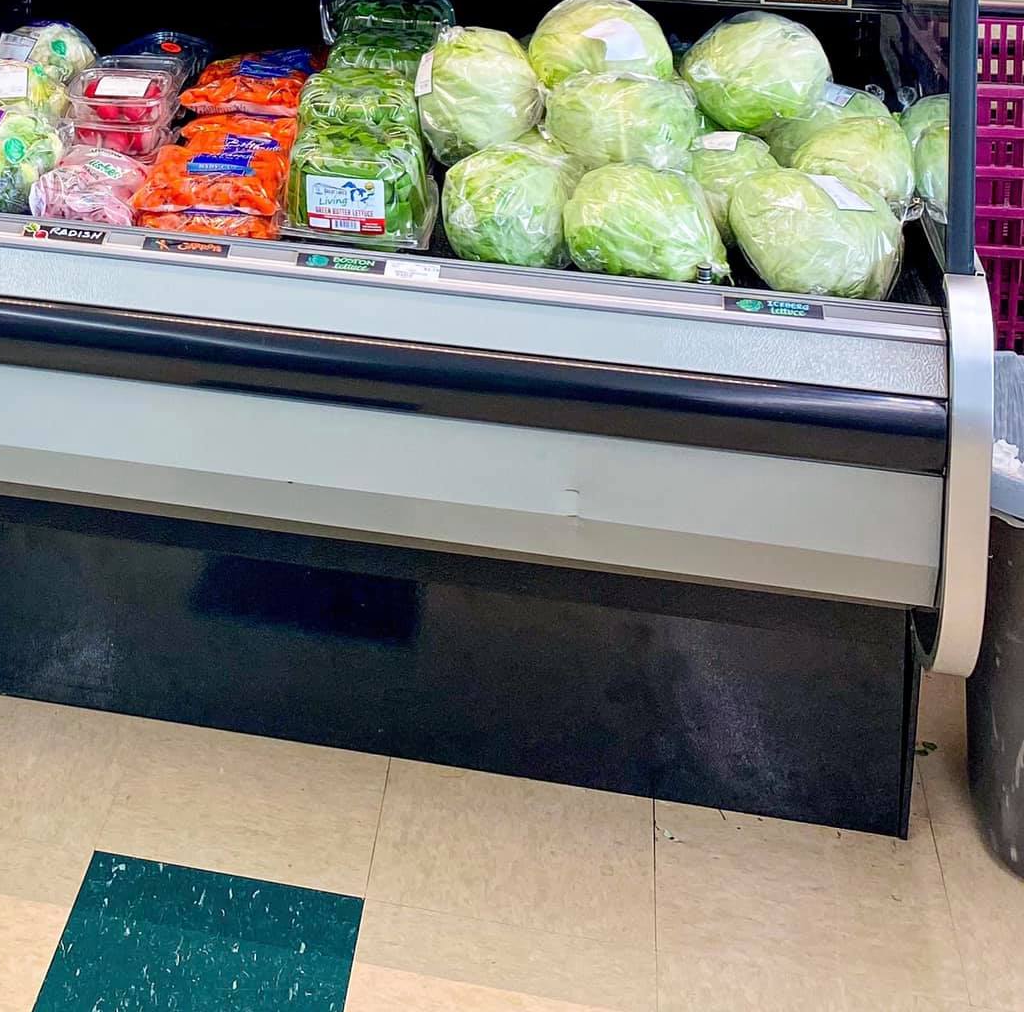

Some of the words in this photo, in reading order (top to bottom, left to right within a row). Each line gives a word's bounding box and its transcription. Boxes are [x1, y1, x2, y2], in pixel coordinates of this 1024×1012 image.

[319, 196, 348, 207] Living
[352, 208, 374, 218] LETTUCE
[49, 227, 103, 240] RADISH
[333, 255, 375, 267] BOSTON
